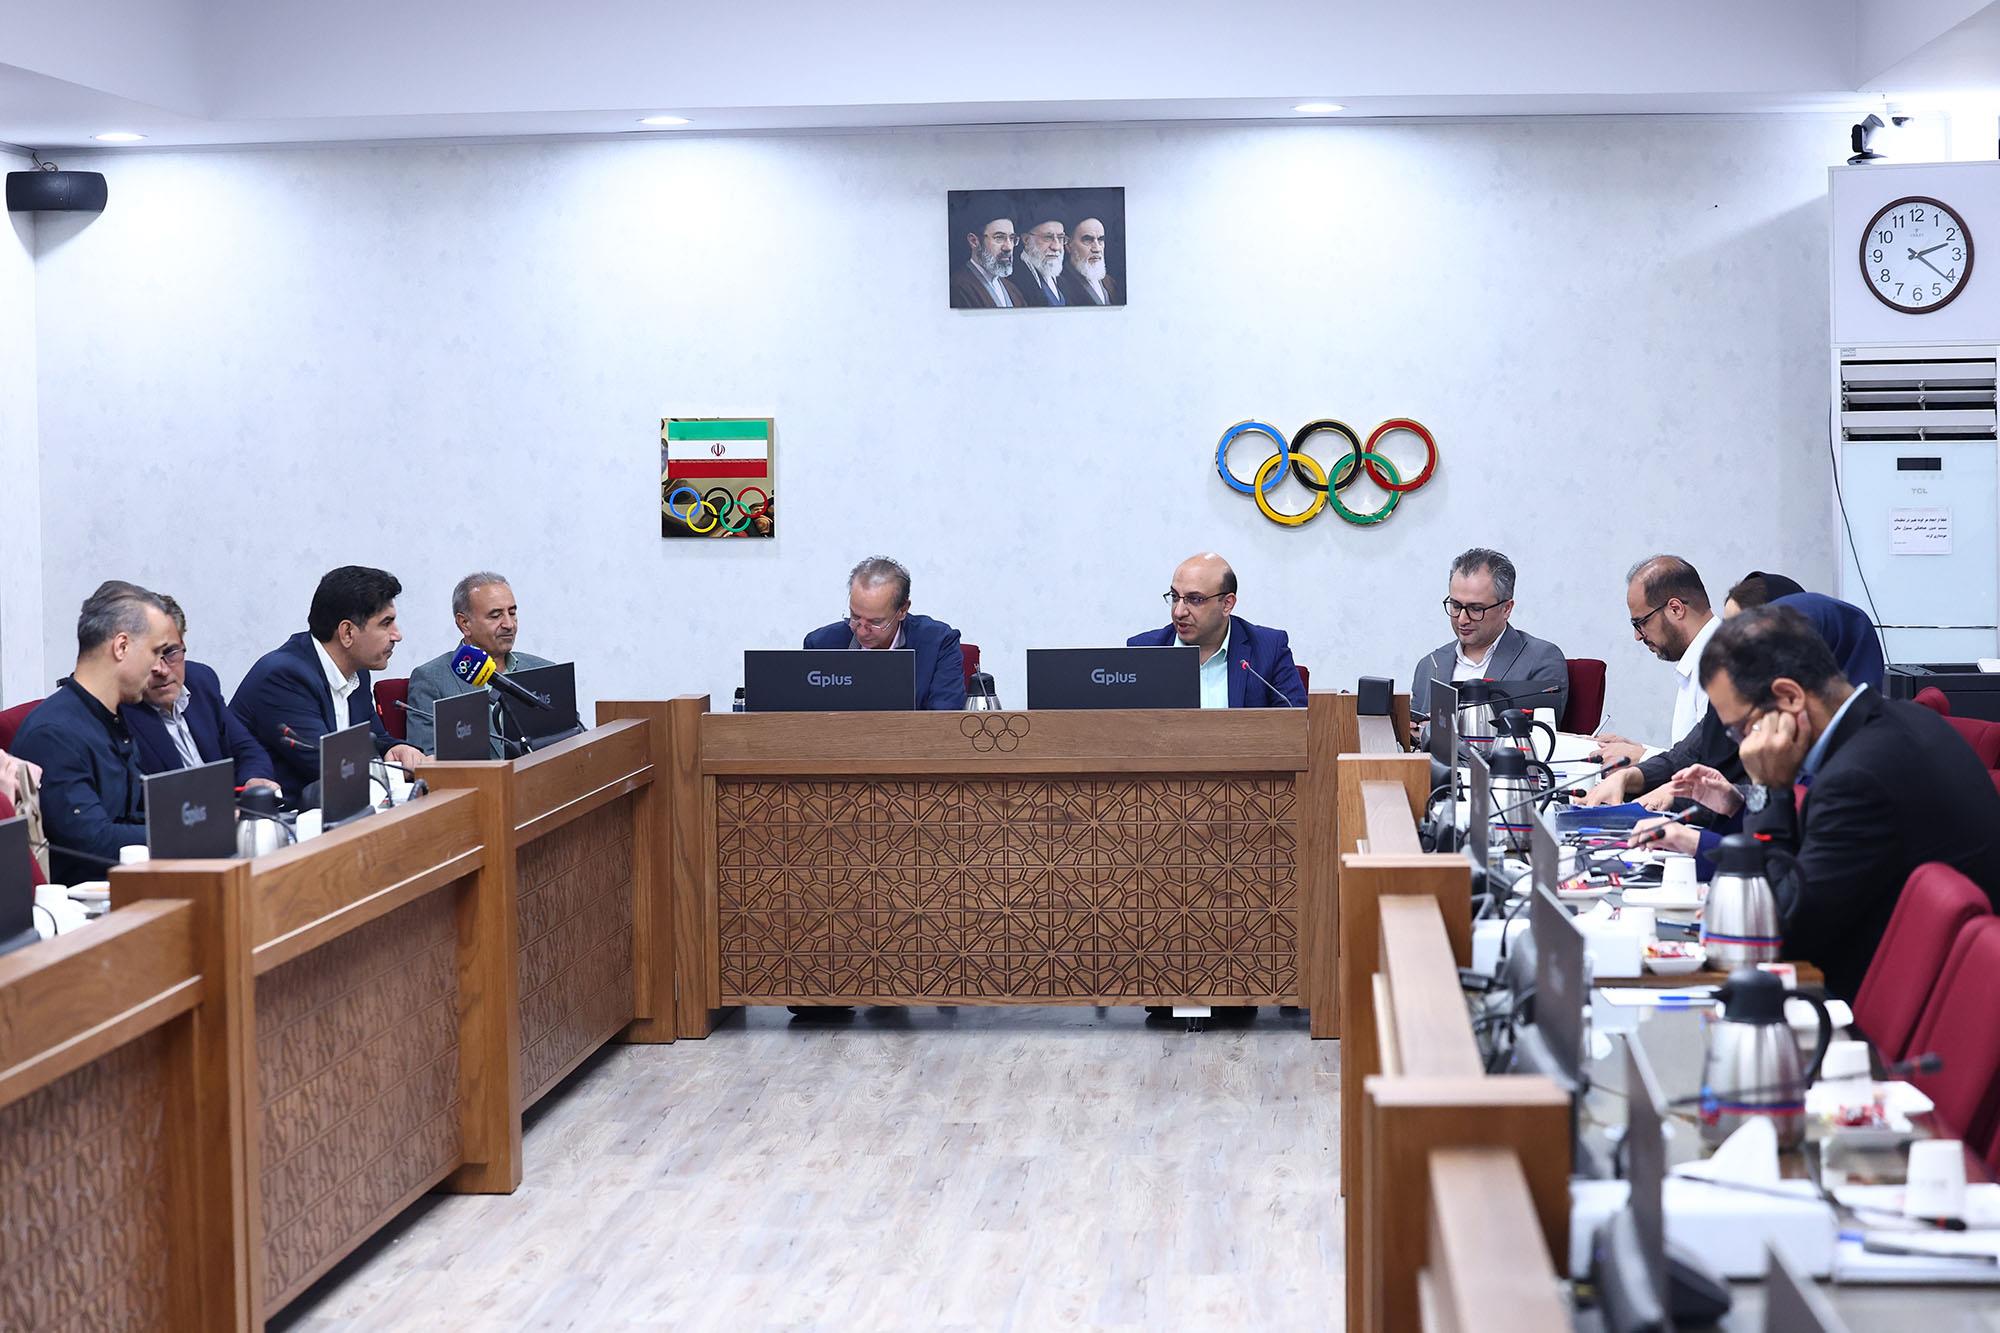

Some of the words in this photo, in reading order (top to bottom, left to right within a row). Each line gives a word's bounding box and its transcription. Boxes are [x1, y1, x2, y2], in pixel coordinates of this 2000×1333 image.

[1892, 215, 1905, 228] 11
[1909, 208, 1925, 222] 12
[1934, 213, 1939, 227] 1
[1878, 230, 1893, 244] 10
[1946, 227, 1956, 241] 2
[1873, 249, 1883, 263] 9
[1952, 247, 1961, 261] 3
[1880, 268, 1890, 282] 8
[1946, 268, 1956, 281] 4
[1895, 282, 1904, 296] 7
[1913, 287, 1923, 301] 6
[1932, 282, 1941, 296] 5
[807, 670, 852, 688] Gplus
[1091, 668, 1137, 686] Gplus
